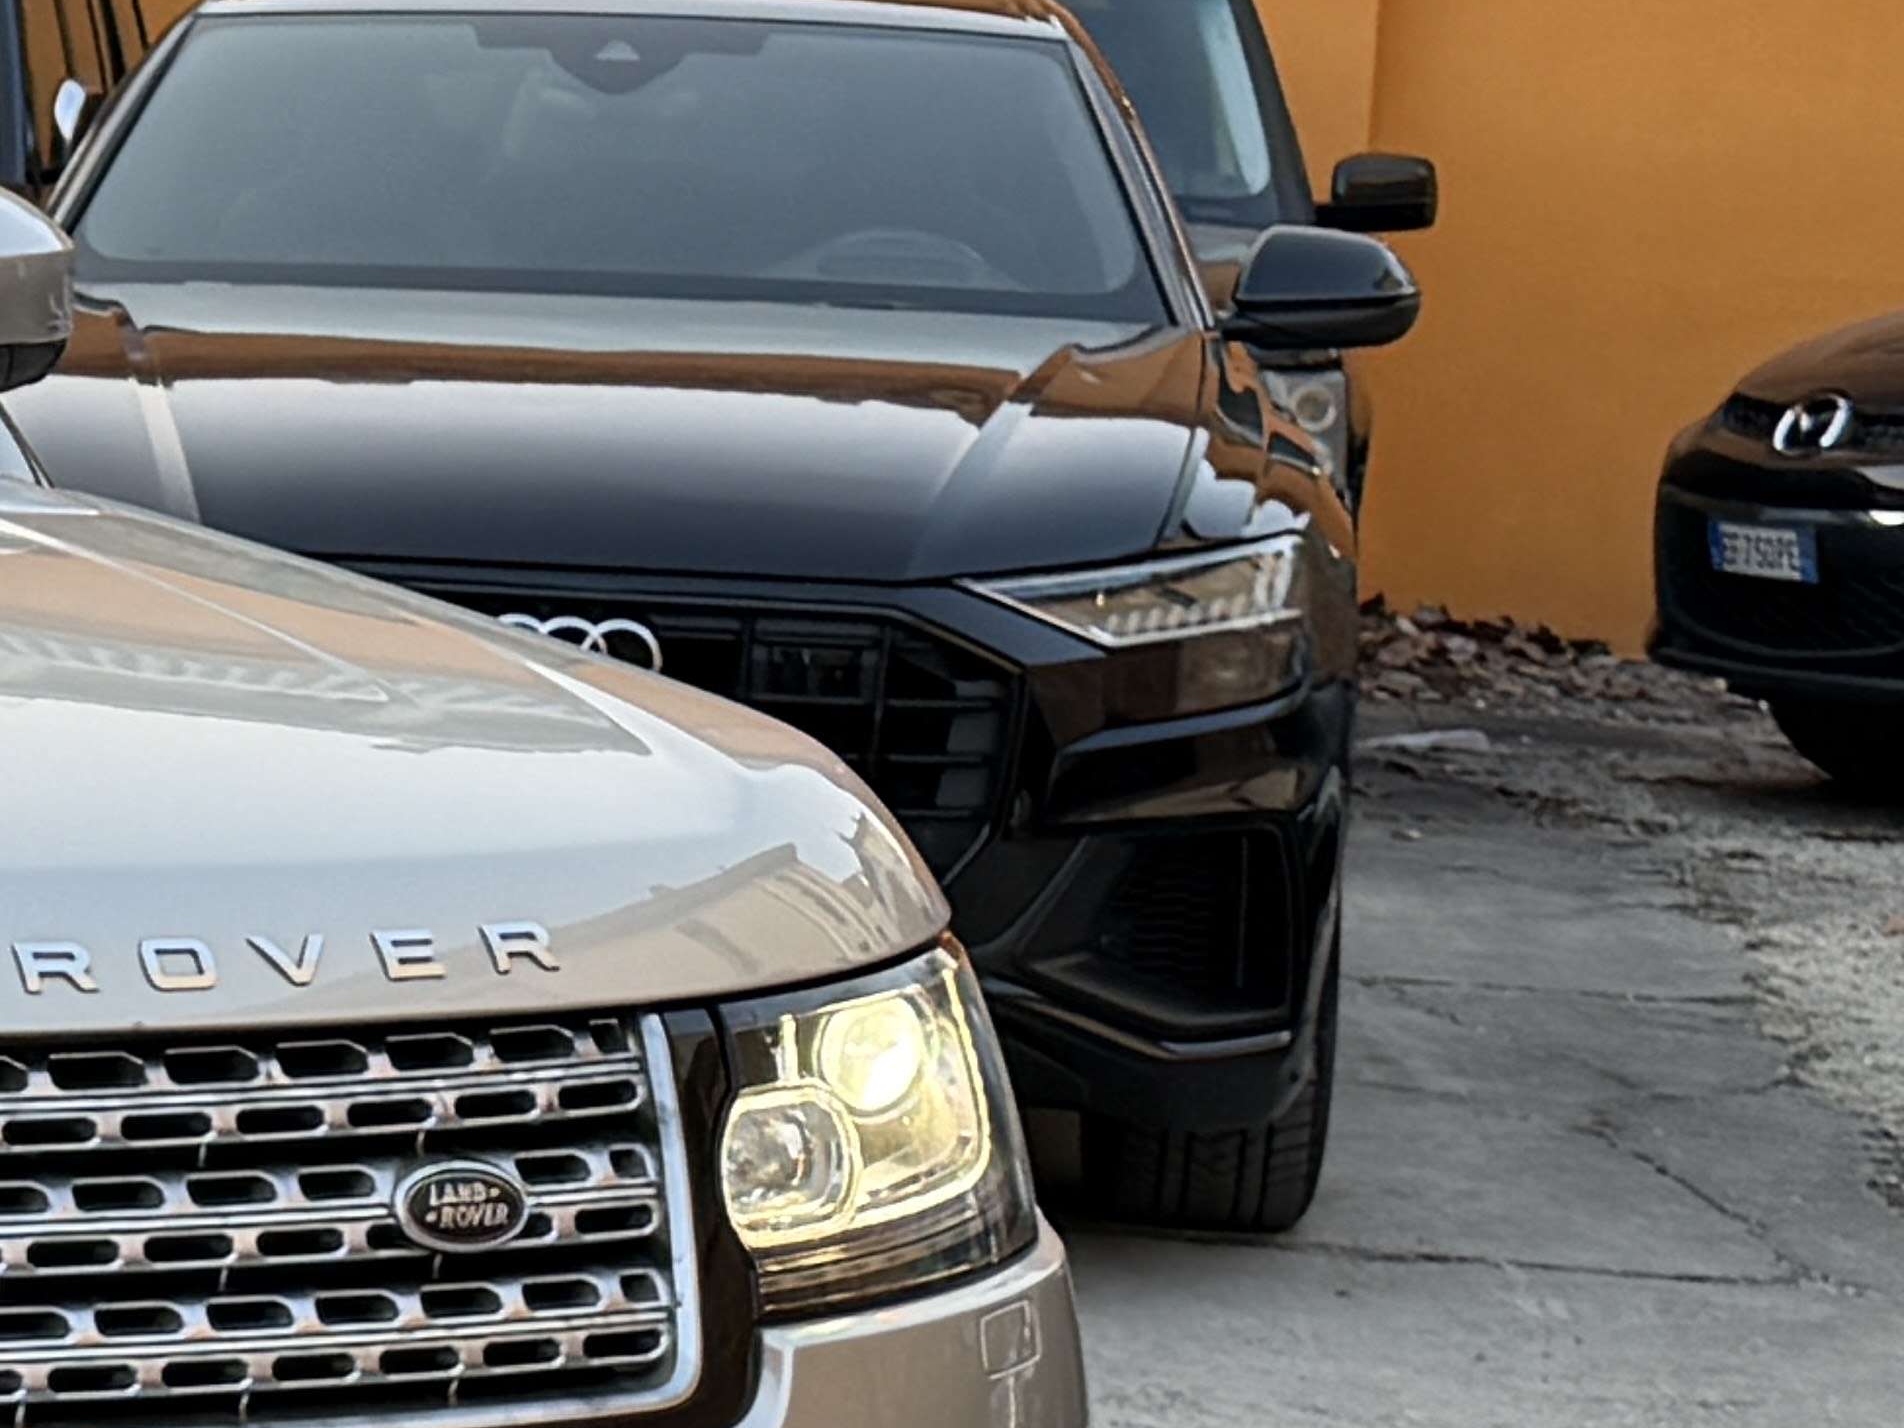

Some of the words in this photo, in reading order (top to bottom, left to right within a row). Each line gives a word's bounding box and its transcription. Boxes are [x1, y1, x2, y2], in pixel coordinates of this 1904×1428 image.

[10, 920, 561, 994] ROVER
[429, 1181, 488, 1207] LAND
[438, 1202, 510, 1229] ROVER
